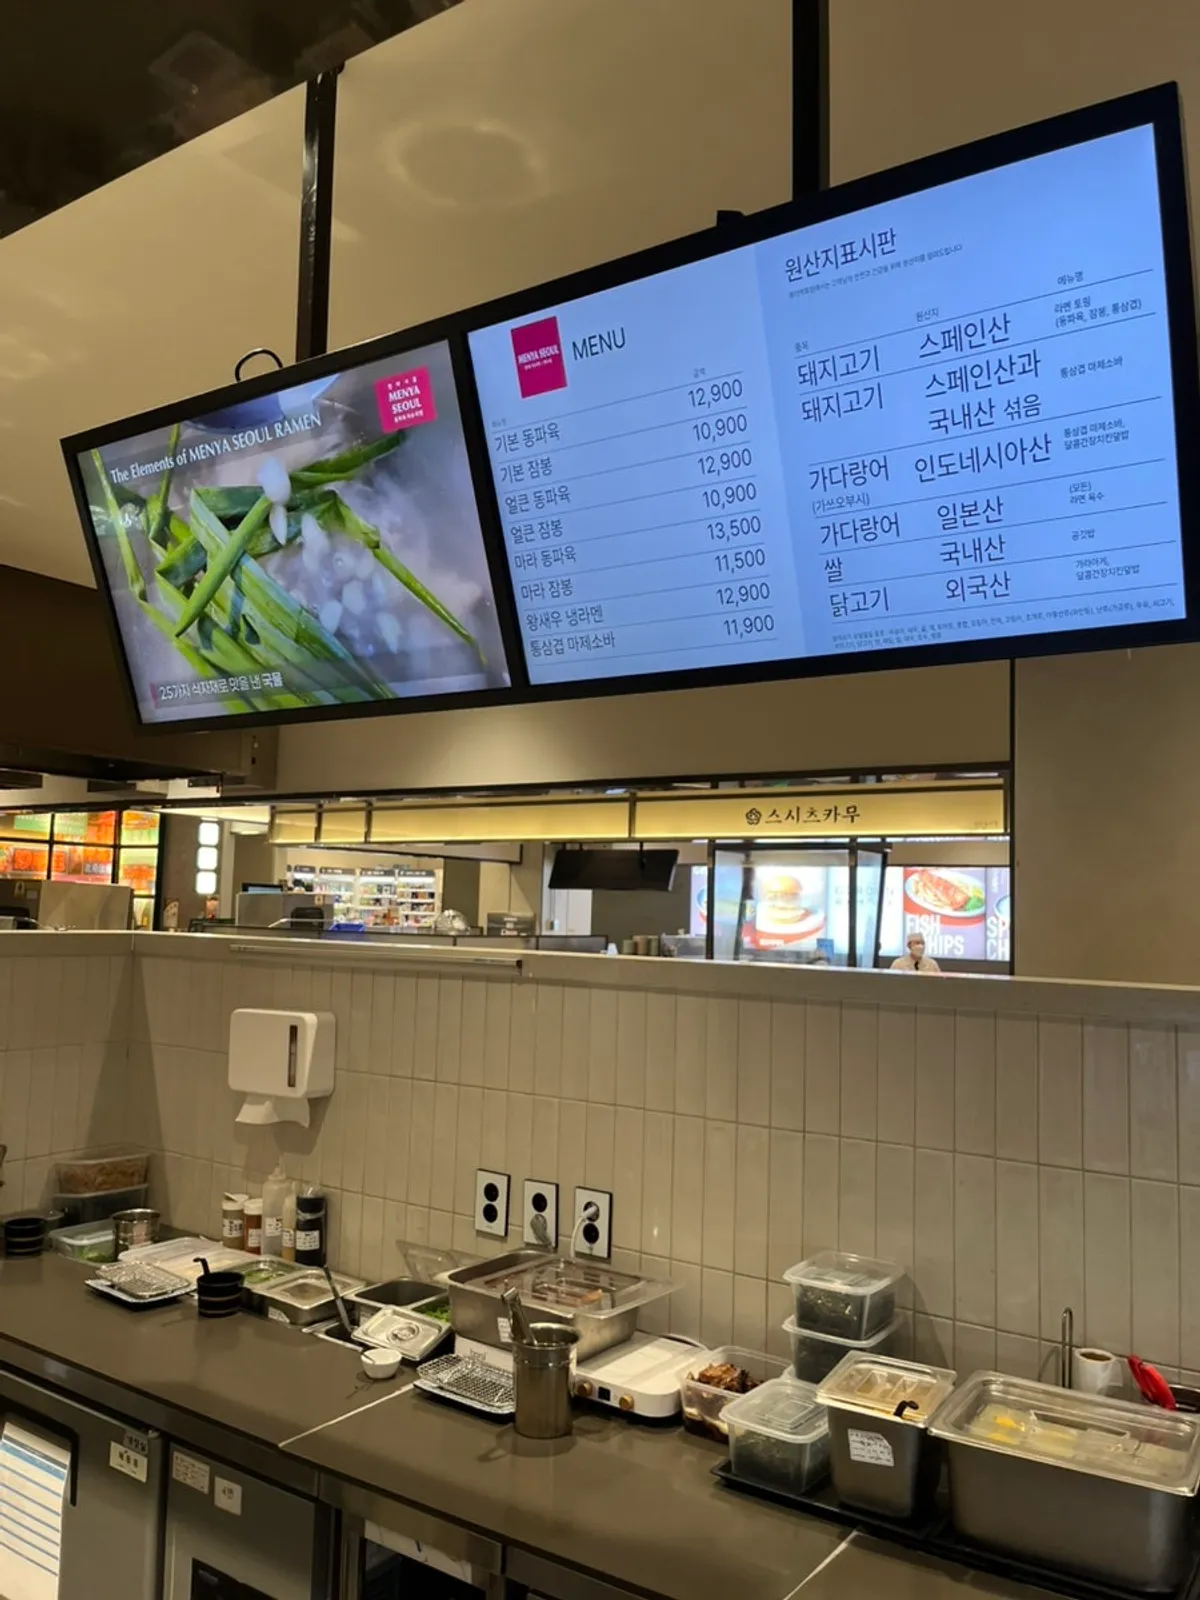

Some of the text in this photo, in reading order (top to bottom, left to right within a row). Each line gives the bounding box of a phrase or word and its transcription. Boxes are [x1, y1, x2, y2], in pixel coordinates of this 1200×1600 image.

[785, 227, 896, 283] 원산지표시판
[916, 308, 939, 323] 원산지
[572, 327, 626, 360] MENU
[797, 312, 1011, 387] 돼지고기 스페인산
[388, 385, 420, 402] MENYA
[392, 398, 422, 414] SEOUL
[802, 382, 883, 423] 돼지고기
[925, 349, 1041, 398] 스페인산과
[495, 433, 519, 453] 기본
[523, 422, 560, 448] 동파육
[688, 379, 743, 409] 12,900
[928, 393, 1042, 435] 국내산 섞음
[110, 412, 321, 484] The Elements of MENYA SEOUL RAMEN
[500, 414, 747, 484] 기본 잠봉 10,900
[809, 432, 1052, 493] 가다랑어 인도네시아산
[505, 448, 752, 515] 얼큰 동파육 12,900
[811, 492, 870, 515] (가쓰오부시)
[510, 482, 757, 545] 얼큰 잠봉 10,900
[820, 495, 1004, 548] 가다랑어 일본산
[514, 516, 761, 571] 마라 동파육 13,500
[824, 557, 843, 583] 쌀
[940, 534, 1006, 567] 국내산
[520, 548, 766, 602] 마라 잠봉 11,500
[830, 570, 1011, 617] 닭고기 외국산
[526, 582, 770, 632] 왕새우 냉라멘 12,900
[530, 614, 775, 658] 통삼겹 마제소바 11,900
[159, 682, 191, 700] 25가지
[192, 679, 228, 696] 식자재로
[262, 671, 283, 688] 국물
[764, 805, 861, 824] 스시츠카무
[906, 914, 940, 937] FISH
